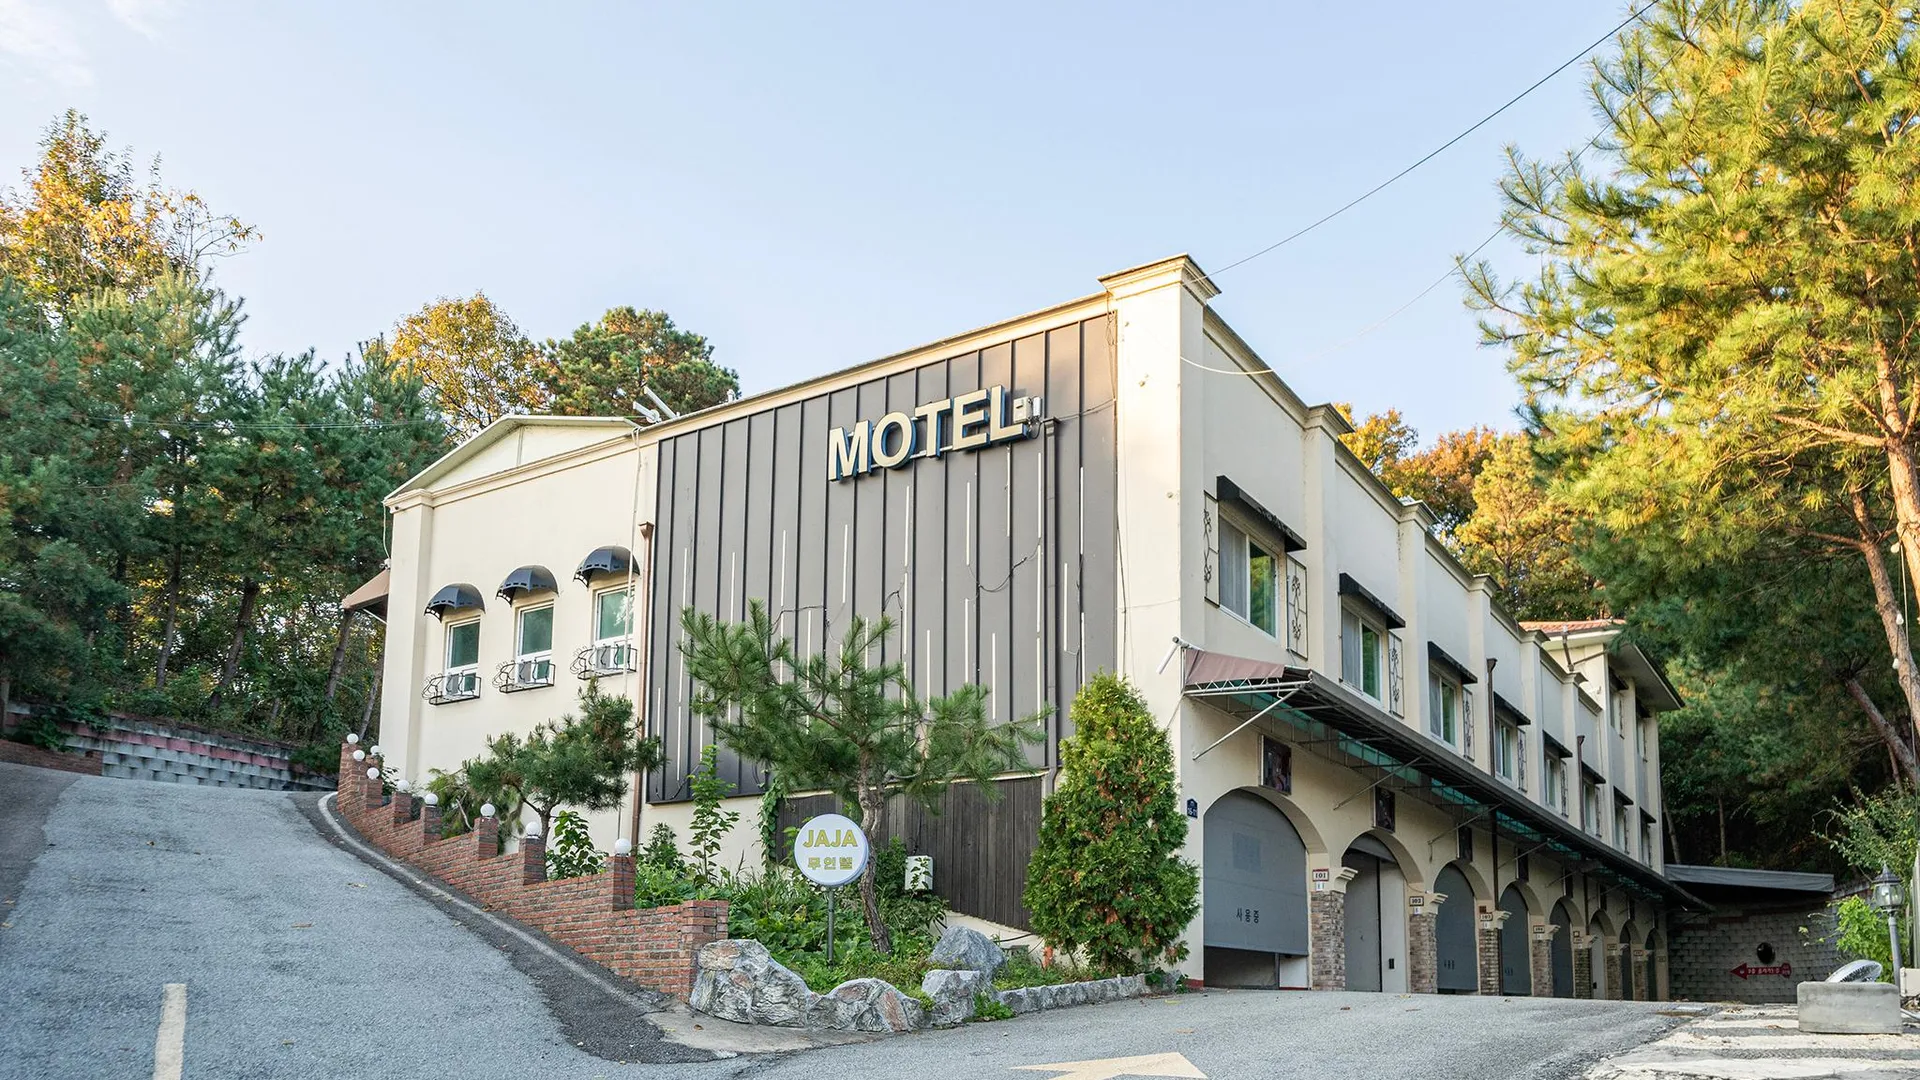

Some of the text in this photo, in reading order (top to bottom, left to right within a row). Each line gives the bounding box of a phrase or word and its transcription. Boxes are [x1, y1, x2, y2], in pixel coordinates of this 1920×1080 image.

[828, 384, 1026, 482] MOTEL
[803, 829, 858, 848] JAJA
[1236, 907, 1259, 924] 사용중
